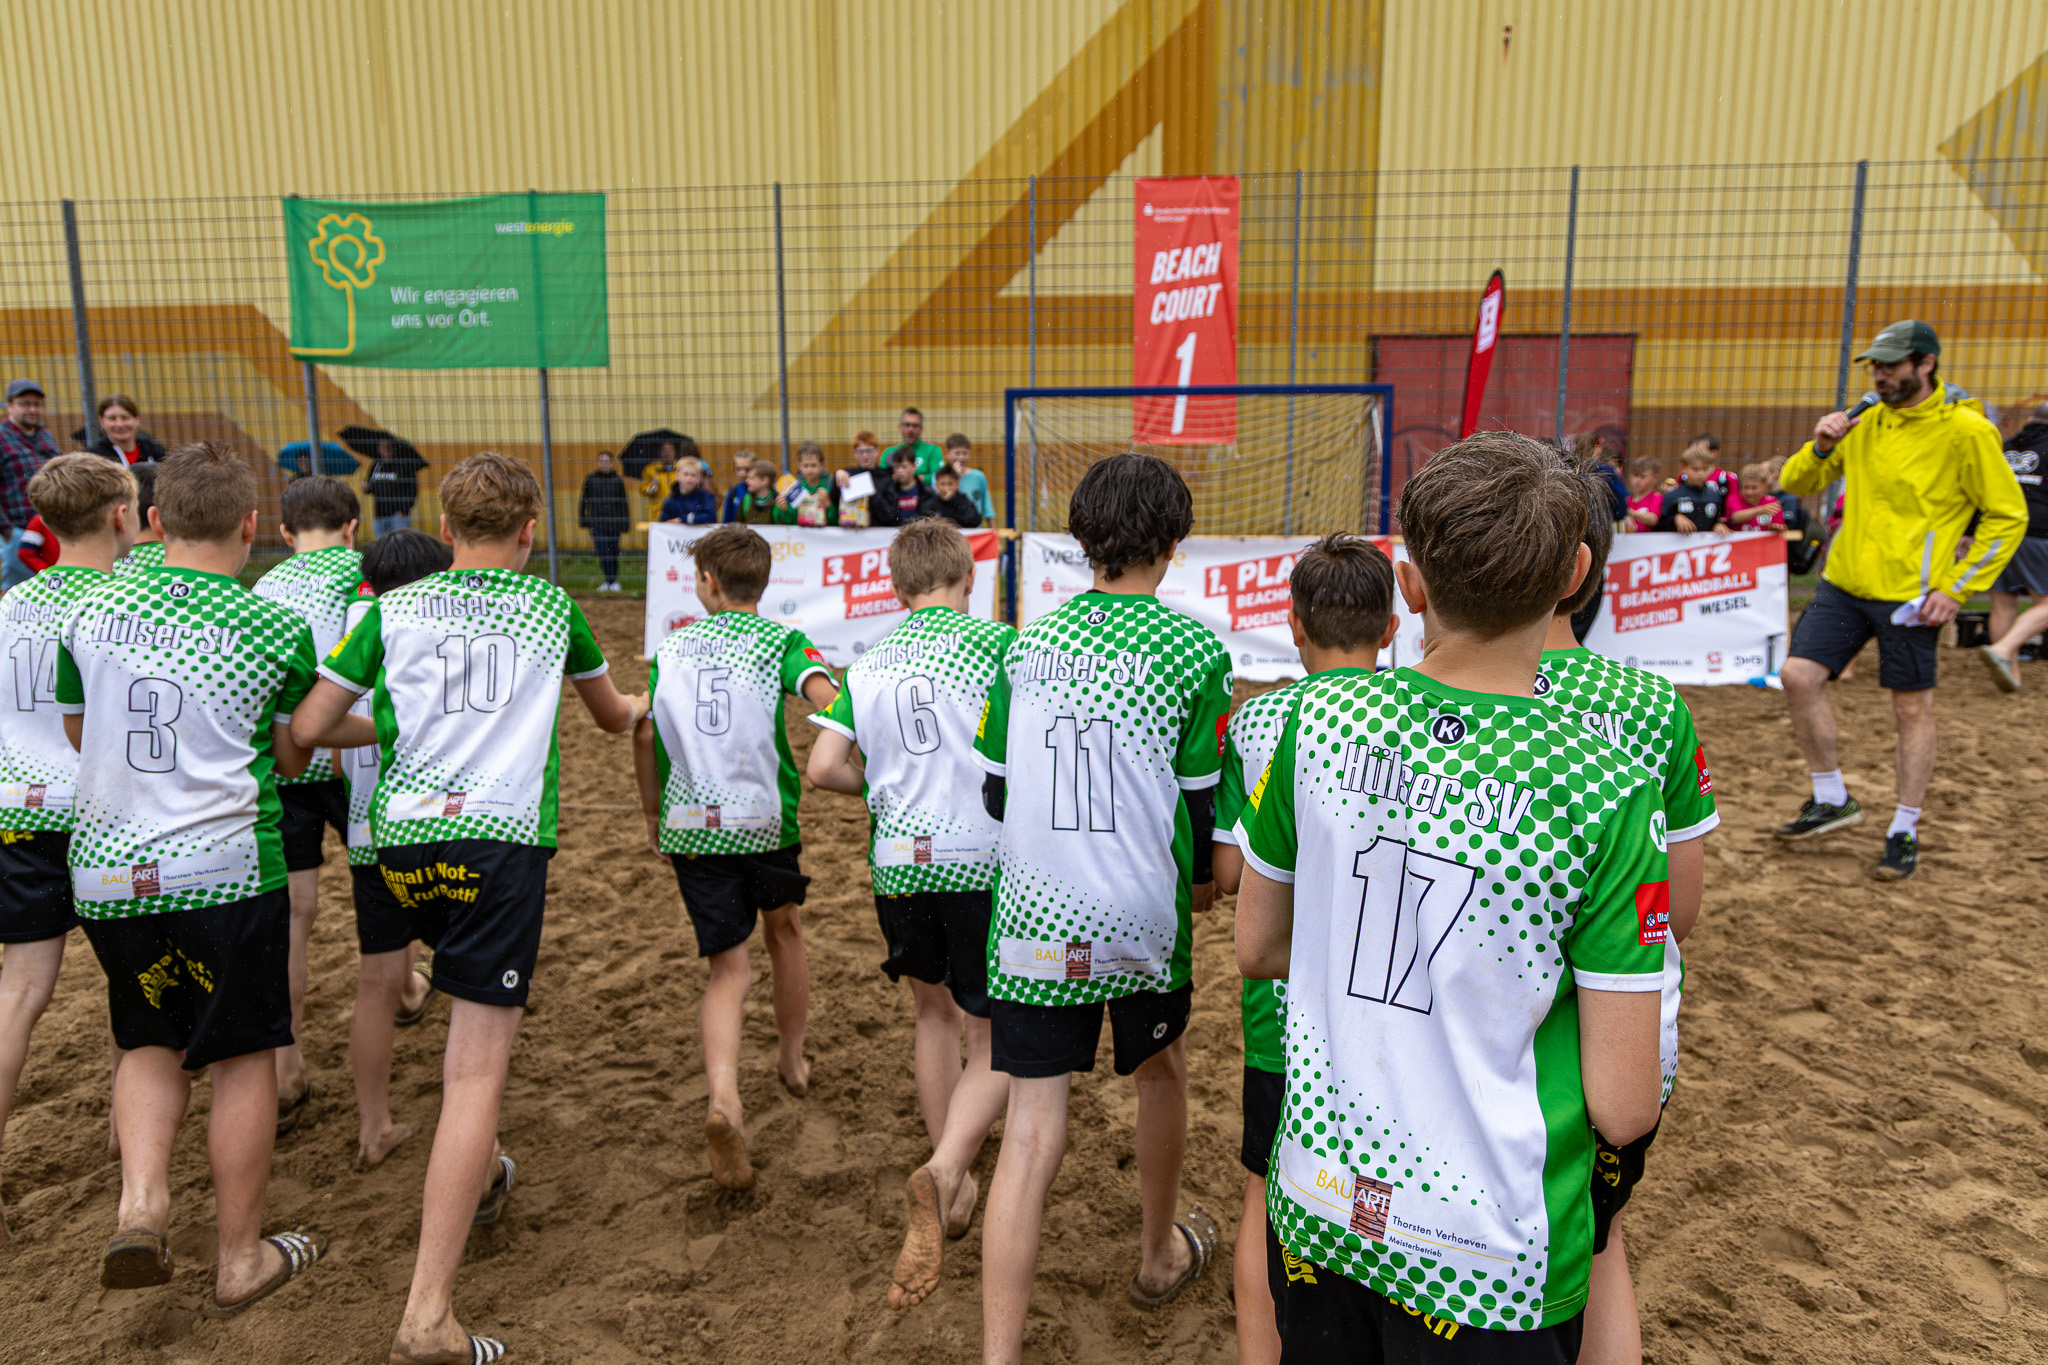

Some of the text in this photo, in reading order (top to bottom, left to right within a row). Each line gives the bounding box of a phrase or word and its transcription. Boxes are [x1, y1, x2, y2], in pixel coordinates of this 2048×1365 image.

[495, 221, 575, 237] westenergie
[1150, 241, 1222, 285] BEACH
[390, 285, 518, 308] Wir engagieren
[1150, 283, 1222, 325] COURT
[391, 309, 492, 328] uns vor Ort.
[1170, 332, 1197, 435] 1
[826, 557, 852, 584] 3.
[1209, 553, 1299, 595] 1. PLA
[1630, 543, 1732, 588] PLATZ
[416, 593, 533, 618] Hülser SV
[848, 597, 900, 618] JUGEND
[1620, 572, 1752, 609] BEACHHANDBALL
[1700, 597, 1751, 615] WESEL
[91, 612, 243, 657] Hülser SV
[1618, 607, 1679, 631] JUGEND
[735, 632, 759, 654] SV
[933, 631, 962, 655] SV
[9, 638, 61, 711] 14
[436, 633, 517, 714] 10
[1024, 647, 1155, 687] Hülser SV
[695, 667, 732, 736] 5
[895, 674, 941, 756] 6
[127, 677, 183, 773] 3
[1045, 716, 1116, 832] 11
[1340, 741, 1463, 816] Hülser
[1467, 776, 1535, 836] SV
[894, 840, 931, 852] BAU ART
[101, 868, 158, 887] BAU ART
[1347, 834, 1478, 1016] 17
[1035, 948, 1091, 962] BAU ART
[1316, 1168, 1391, 1214] BAU ART
[1388, 1235, 1443, 1258] Meisterbetrieb
[1392, 1215, 1488, 1250] Thorsten Verhoeven
